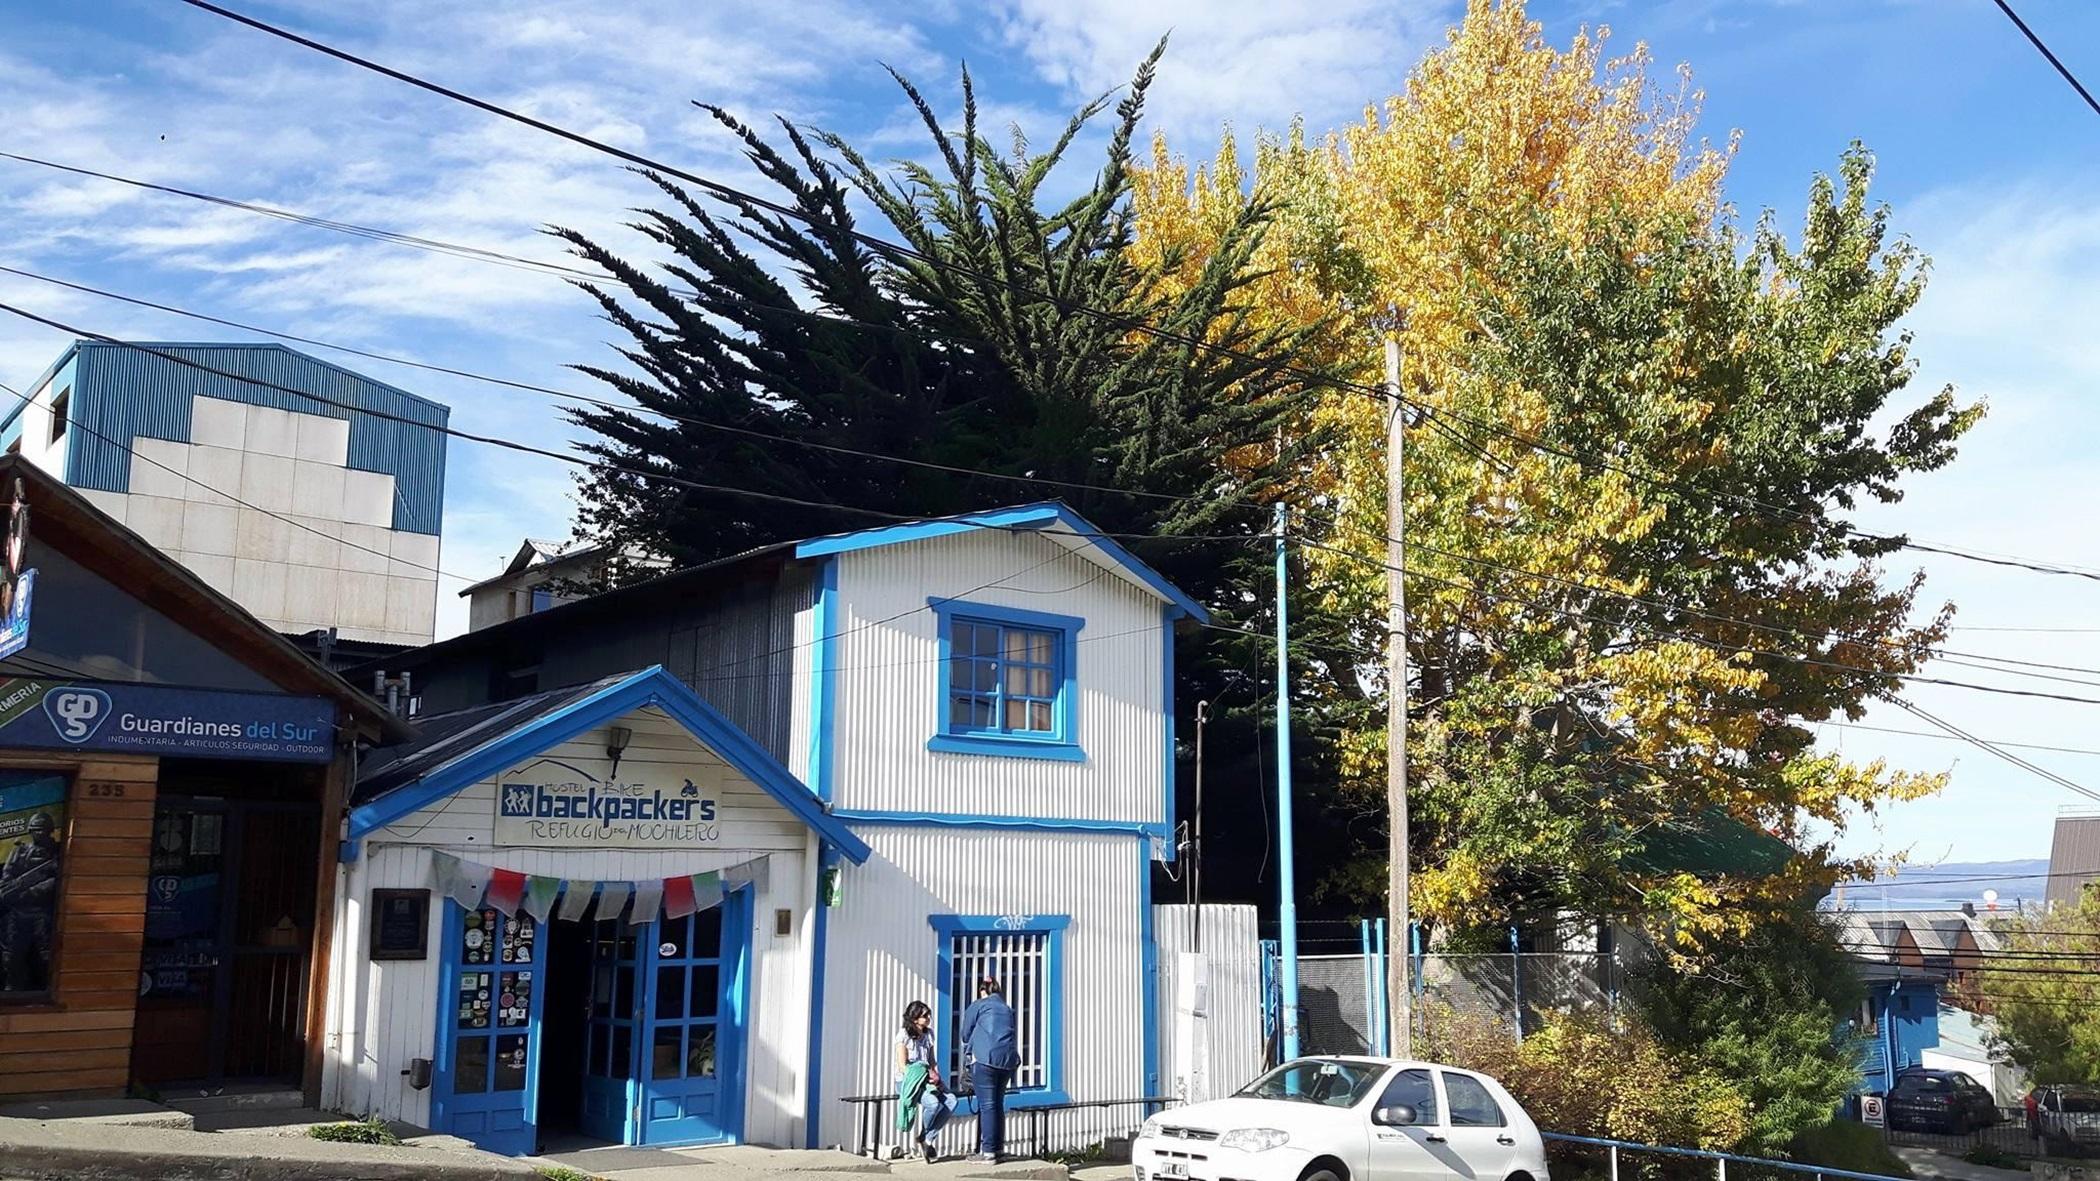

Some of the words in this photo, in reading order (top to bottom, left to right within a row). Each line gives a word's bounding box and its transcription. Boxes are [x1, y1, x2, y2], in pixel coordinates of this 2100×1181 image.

[120, 713, 242, 737] Guardianes
[246, 721, 277, 739] del
[282, 723, 318, 741] Sur
[107, 735, 176, 745] INDUMENTARIA
[183, 740, 231, 750] ARTICULOS
[232, 742, 279, 751] SEGURIDAD
[286, 744, 325, 753] OUTDOOR
[88, 784, 126, 797] 235
[544, 782, 586, 793] HOSTEL
[601, 781, 645, 797] BIKE
[535, 785, 716, 828] backpackers
[526, 820, 613, 840] REFUGIO
[627, 822, 719, 841] MOCHILERO
